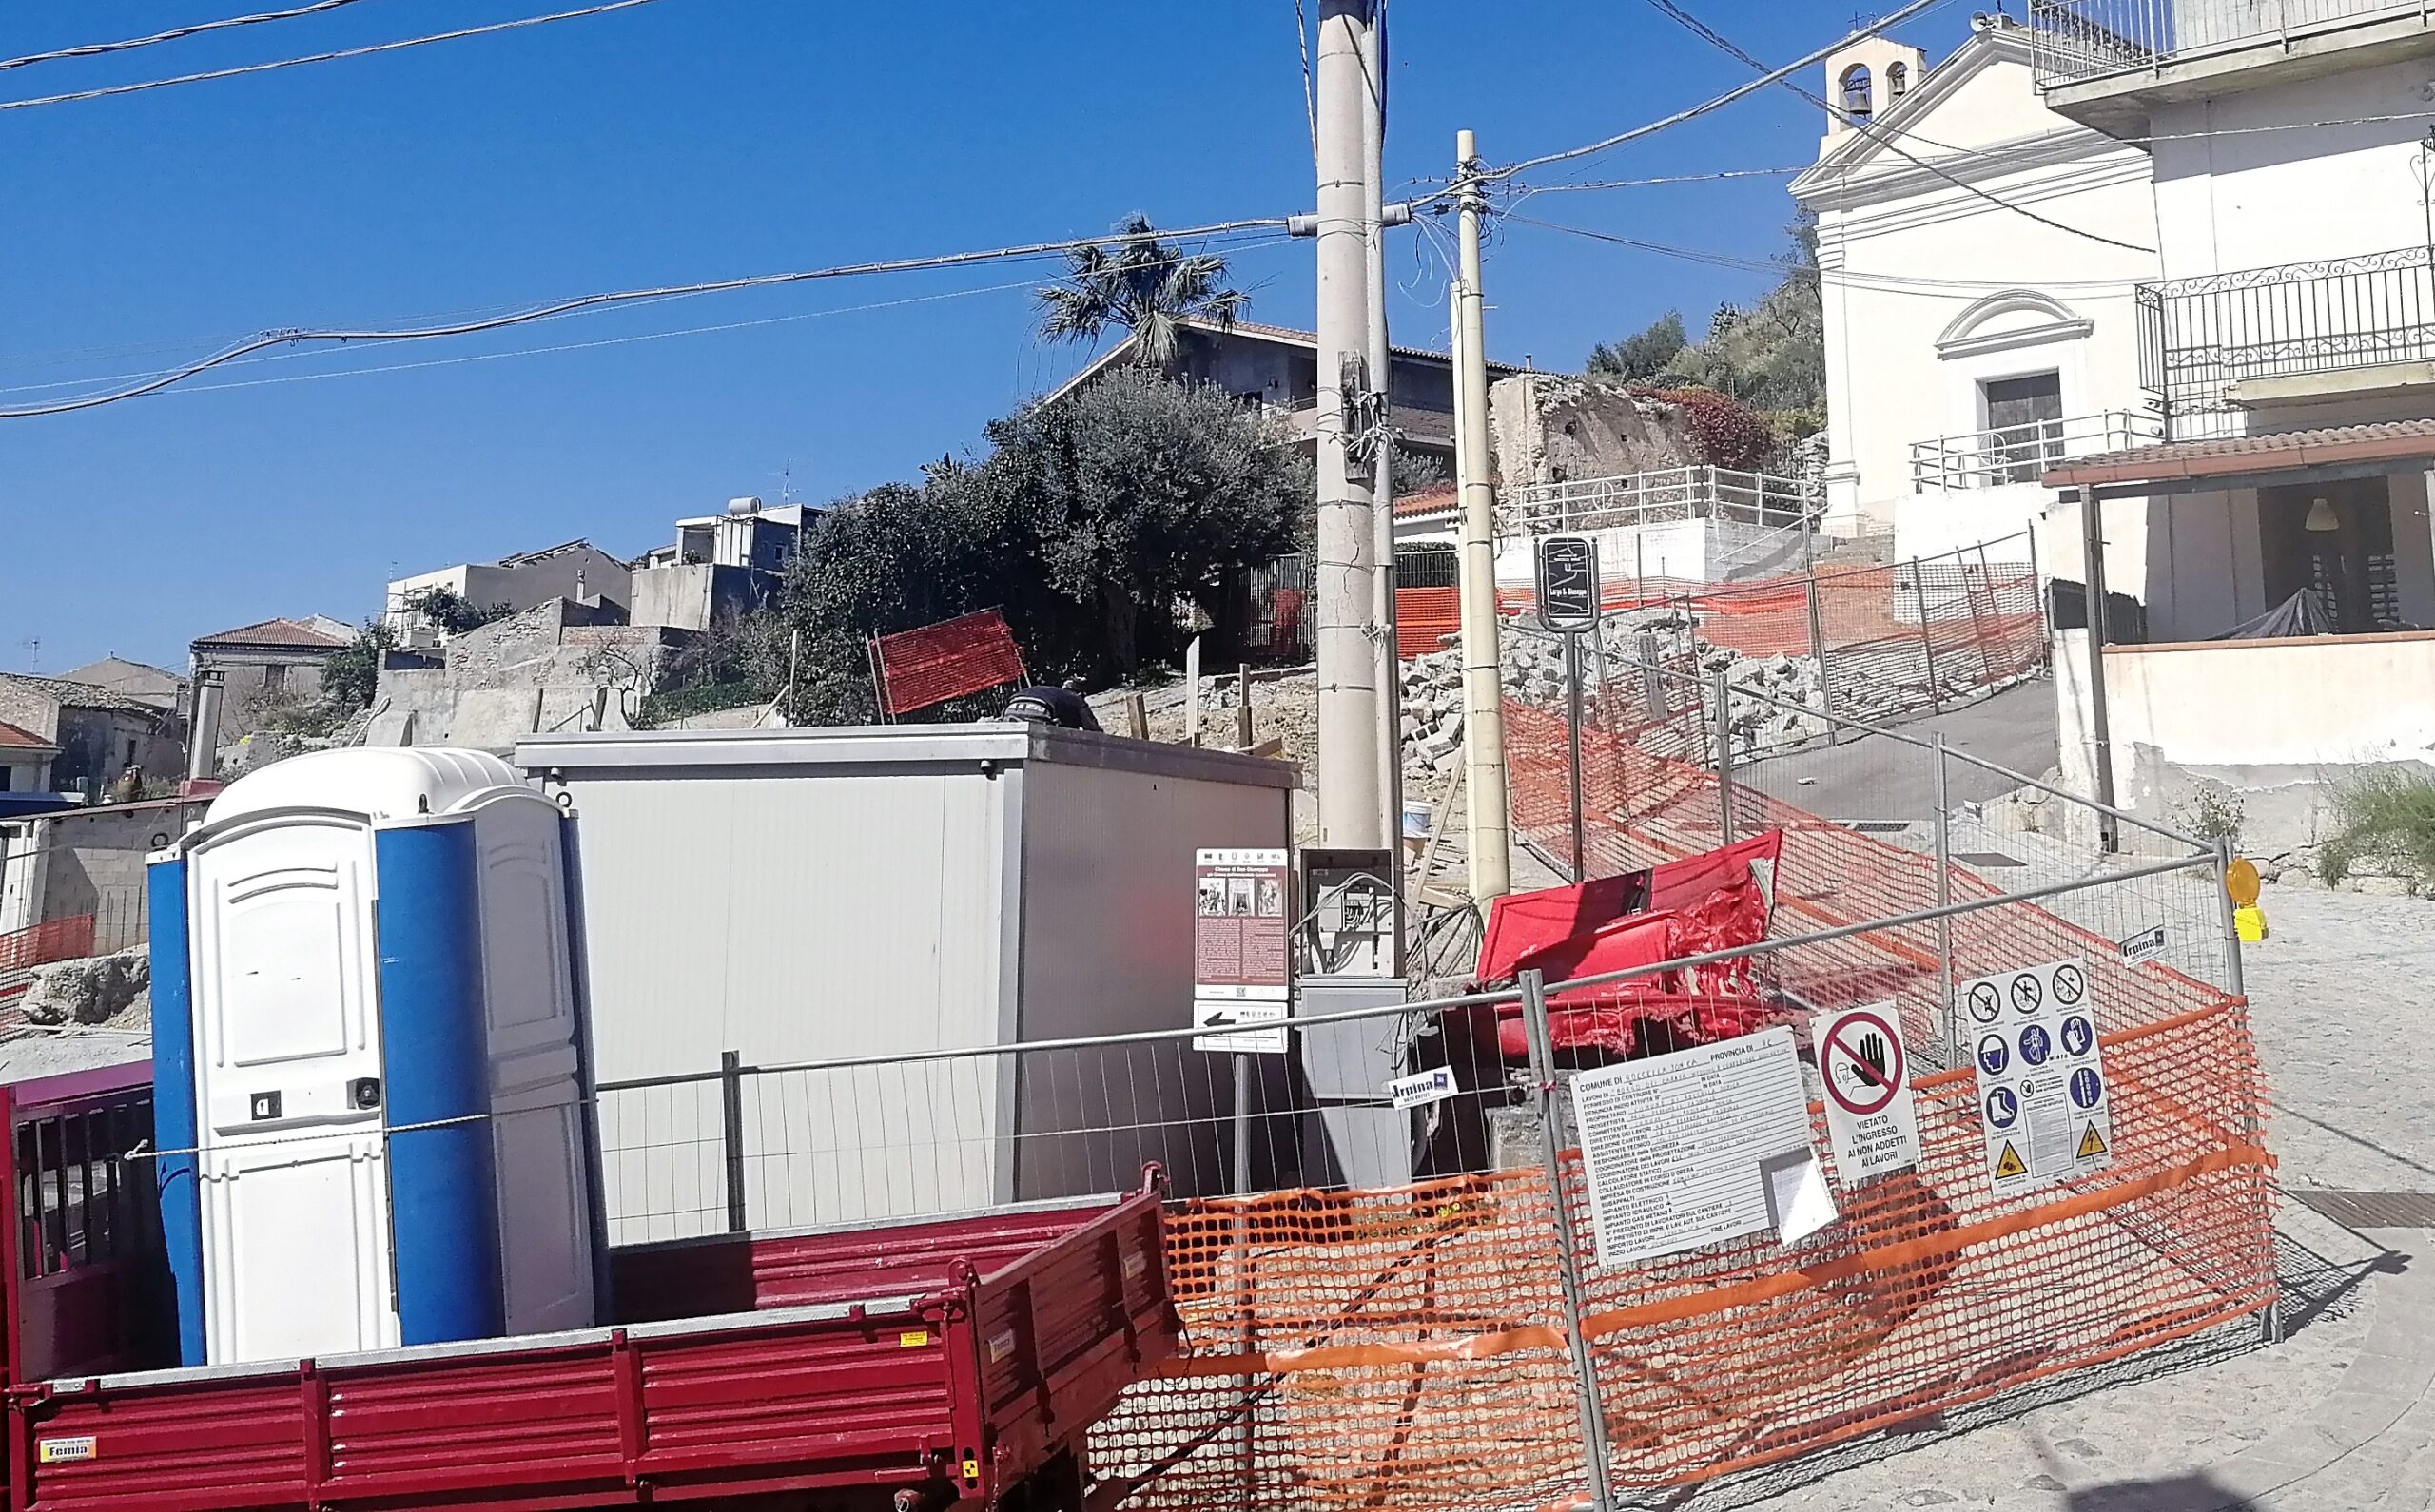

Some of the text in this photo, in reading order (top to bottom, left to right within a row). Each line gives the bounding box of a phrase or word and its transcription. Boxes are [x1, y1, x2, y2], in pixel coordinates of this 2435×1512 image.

[1710, 1047, 1745, 1060] PROVINCIA
[1745, 1043, 1753, 1052] DI
[1579, 1078, 1612, 1092] COMUNE
[1613, 1076, 1623, 1084] DI
[1857, 1115, 1888, 1130] VIETATO
[1589, 1134, 1619, 1144] DIRETTORE
[1591, 1134, 1646, 1151] DIREZIONE CANTIERE
[1852, 1125, 1898, 1145] L'INGRESSO
[1592, 1140, 1650, 1158] ASSISTENTE TECNICO
[1594, 1152, 1634, 1165] RESPONSABILE
[1650, 1141, 1679, 1152] SICUREZZA
[1848, 1135, 1907, 1159] AI NON ADDETTI
[1595, 1158, 1637, 1173] COORDINATORE
[1652, 1145, 1695, 1158] PROGETTAZIONE
[1861, 1151, 1898, 1168] AI LAVORI
[1596, 1165, 1638, 1179] COORDINATORE
[1597, 1168, 1661, 1186] CALCOLATORE STATICO
[1598, 1179, 1642, 1193] COLLAUDATORE
[1600, 1191, 1624, 1200] IMPRESA
[1632, 1180, 1669, 1192] COSTRUZIONE
[1601, 1195, 1634, 1208] SUBAPPALTI
[1602, 1196, 1663, 1214] IMPIANTO ELETTRICO
[1603, 1203, 1664, 1222] IMPIANTO IDRAULICO
[1605, 1218, 1630, 1229] IMPIANTO
[1645, 1210, 1667, 1219] METANO
[1612, 1223, 1643, 1234] PRESUNTO
[1651, 1212, 1685, 1225] LAVORATORI
[1697, 1203, 1722, 1213] CANTIERE
[1613, 1231, 1641, 1241] PREVISTO
[1706, 1208, 1731, 1218] CANTIERE
[1607, 1239, 1632, 1250] IMPORTO
[1634, 1234, 1654, 1243] LAVORI
[1626, 1244, 1646, 1252] LAVORI
[49, 1446, 88, 1456] Femia
